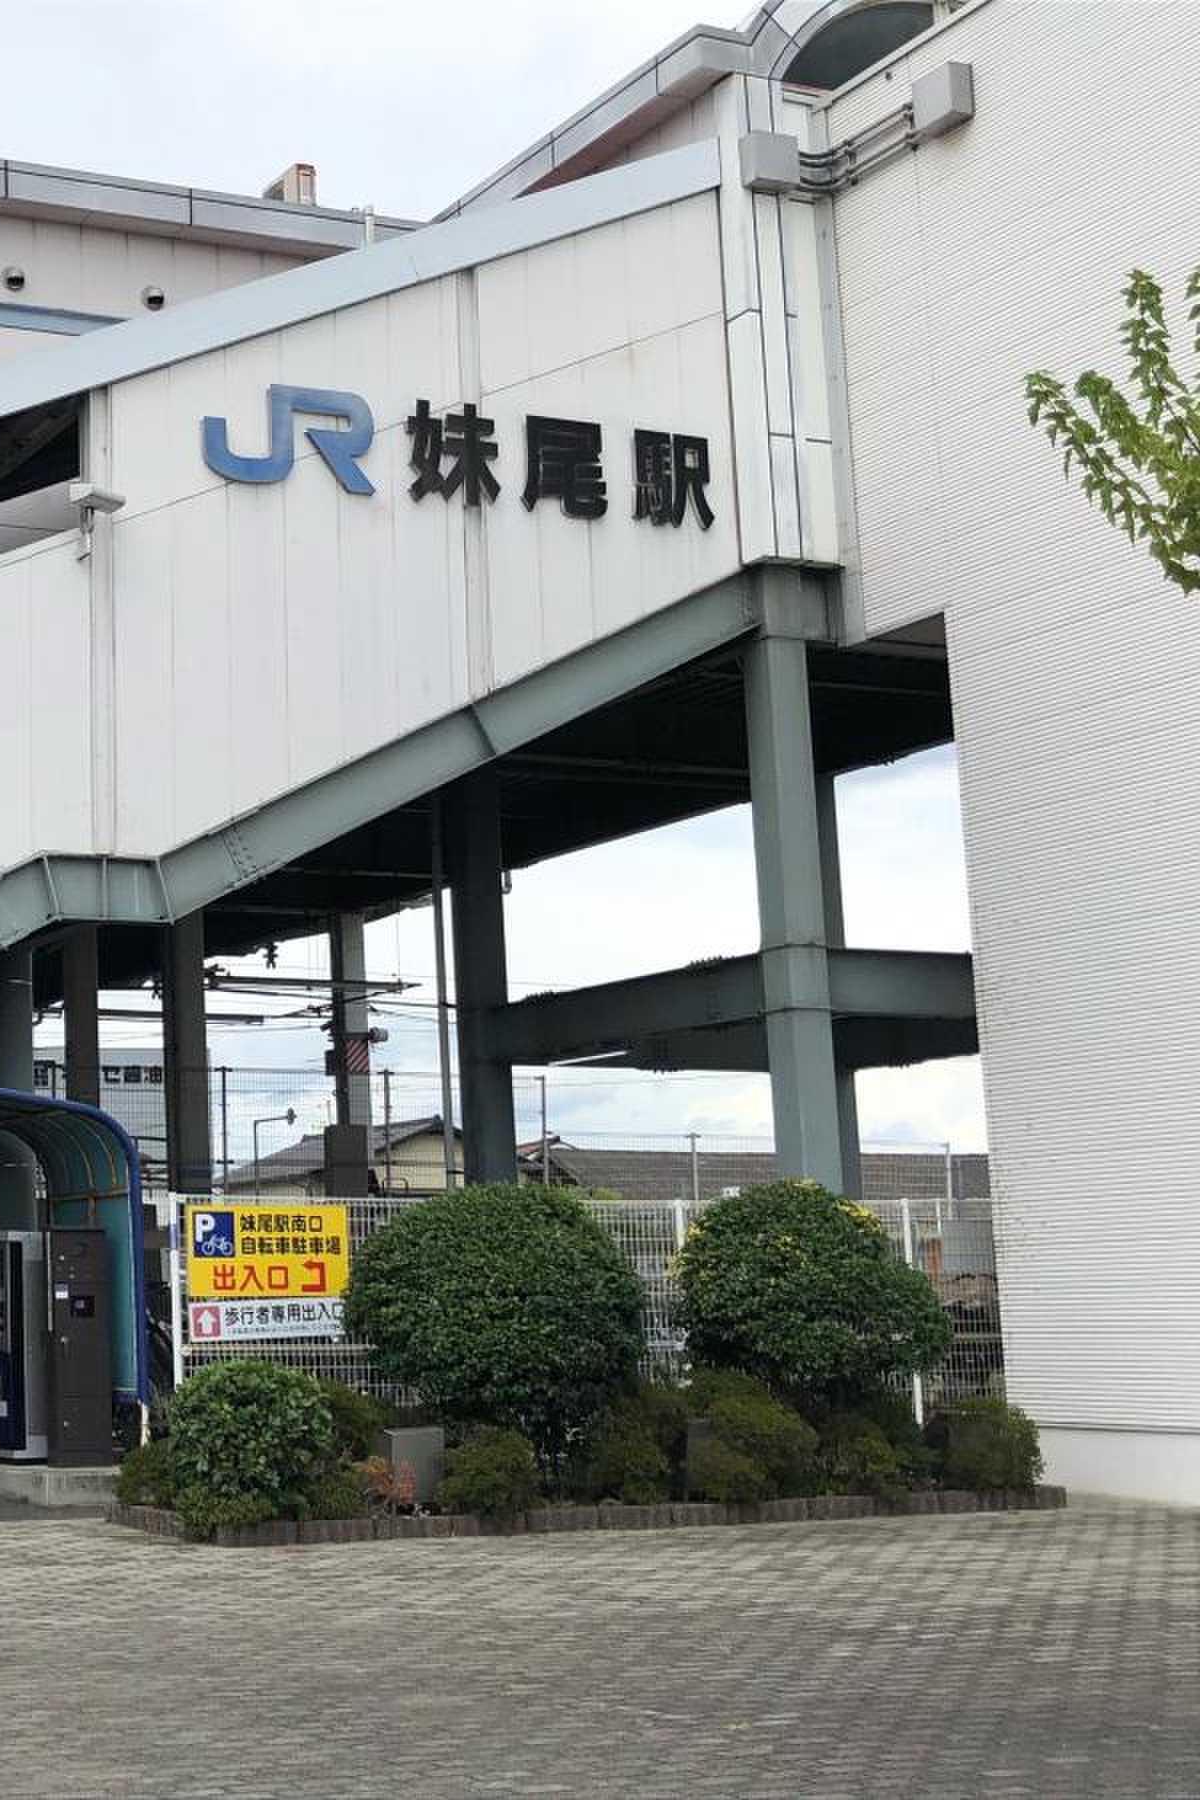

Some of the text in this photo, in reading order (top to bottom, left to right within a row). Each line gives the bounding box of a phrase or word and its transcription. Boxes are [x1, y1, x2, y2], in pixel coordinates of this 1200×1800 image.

[202, 384, 717, 530] JR 妹尾駅
[195, 1213, 216, 1243] P
[240, 1214, 323, 1233] 妹尾駅南口
[241, 1236, 341, 1256] 自転車駐車場
[213, 1264, 289, 1292] 出入口
